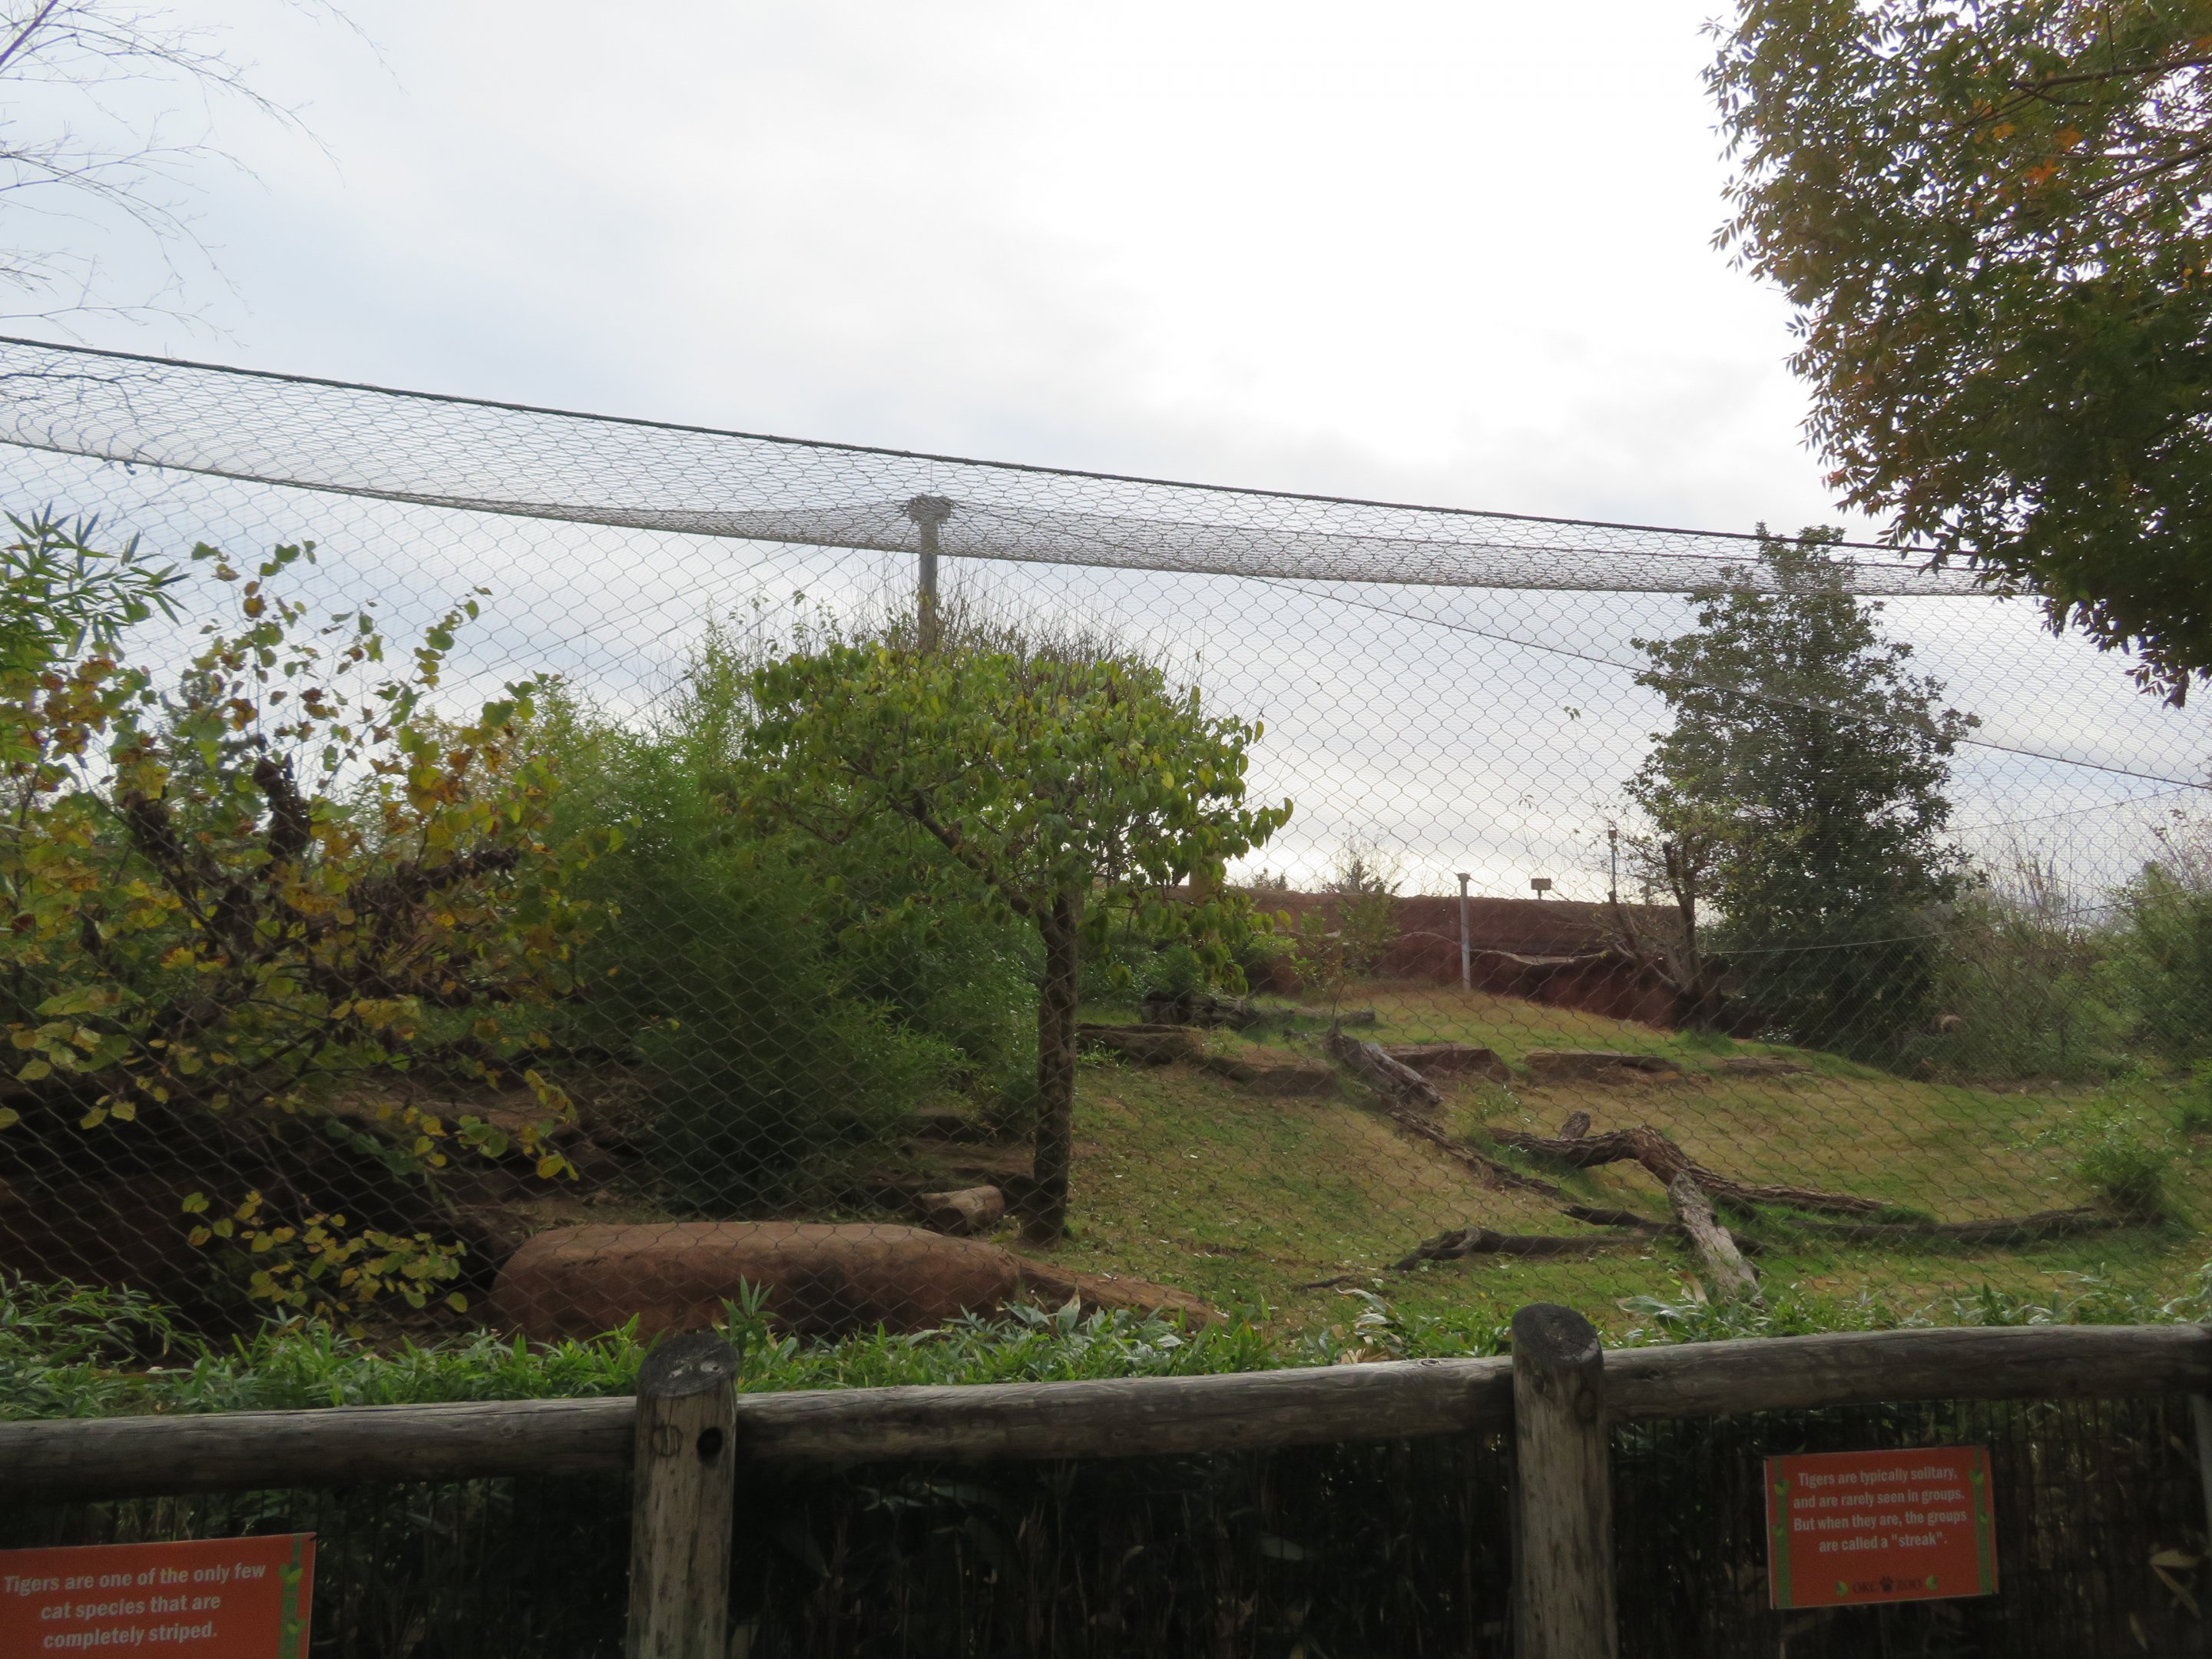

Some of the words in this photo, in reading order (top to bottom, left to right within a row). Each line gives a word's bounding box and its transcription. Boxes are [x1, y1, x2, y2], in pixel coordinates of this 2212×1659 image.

[1798, 1472, 1834, 1488] Tigers
[1838, 1472, 1857, 1484] are
[1860, 1469, 1907, 1487] typically
[1911, 1467, 1957, 1480] solitary,
[1793, 1497, 1816, 1508] and
[1819, 1496, 1837, 1507] are
[1840, 1492, 1874, 1508] rarely
[1877, 1492, 1905, 1504] seen
[1907, 1490, 1919, 1502] in
[1922, 1488, 1965, 1504] groups.
[1793, 1518, 1815, 1532] But
[1818, 1516, 1849, 1530] when
[1852, 1513, 1876, 1529] they
[1879, 1514, 1902, 1527] are,
[1905, 1512, 1924, 1524] the
[1927, 1511, 1966, 1525] groups
[1819, 1541, 1838, 1552] are
[1841, 1536, 1878, 1551] called
[1881, 1538, 1888, 1548] a
[1892, 1532, 1948, 1548] "streak".
[4, 1576, 59, 1596] Tigers
[65, 1575, 93, 1591] are
[99, 1573, 131, 1588] one
[137, 1568, 154, 1585] of
[161, 1567, 188, 1584] the
[194, 1564, 230, 1584] only
[234, 1562, 266, 1579] few
[40, 1602, 71, 1620] cat
[76, 1599, 144, 1621] species
[151, 1596, 187, 1613] that
[192, 1594, 220, 1610] are
[43, 1626, 144, 1649] completely
[148, 1621, 217, 1644] striped.
